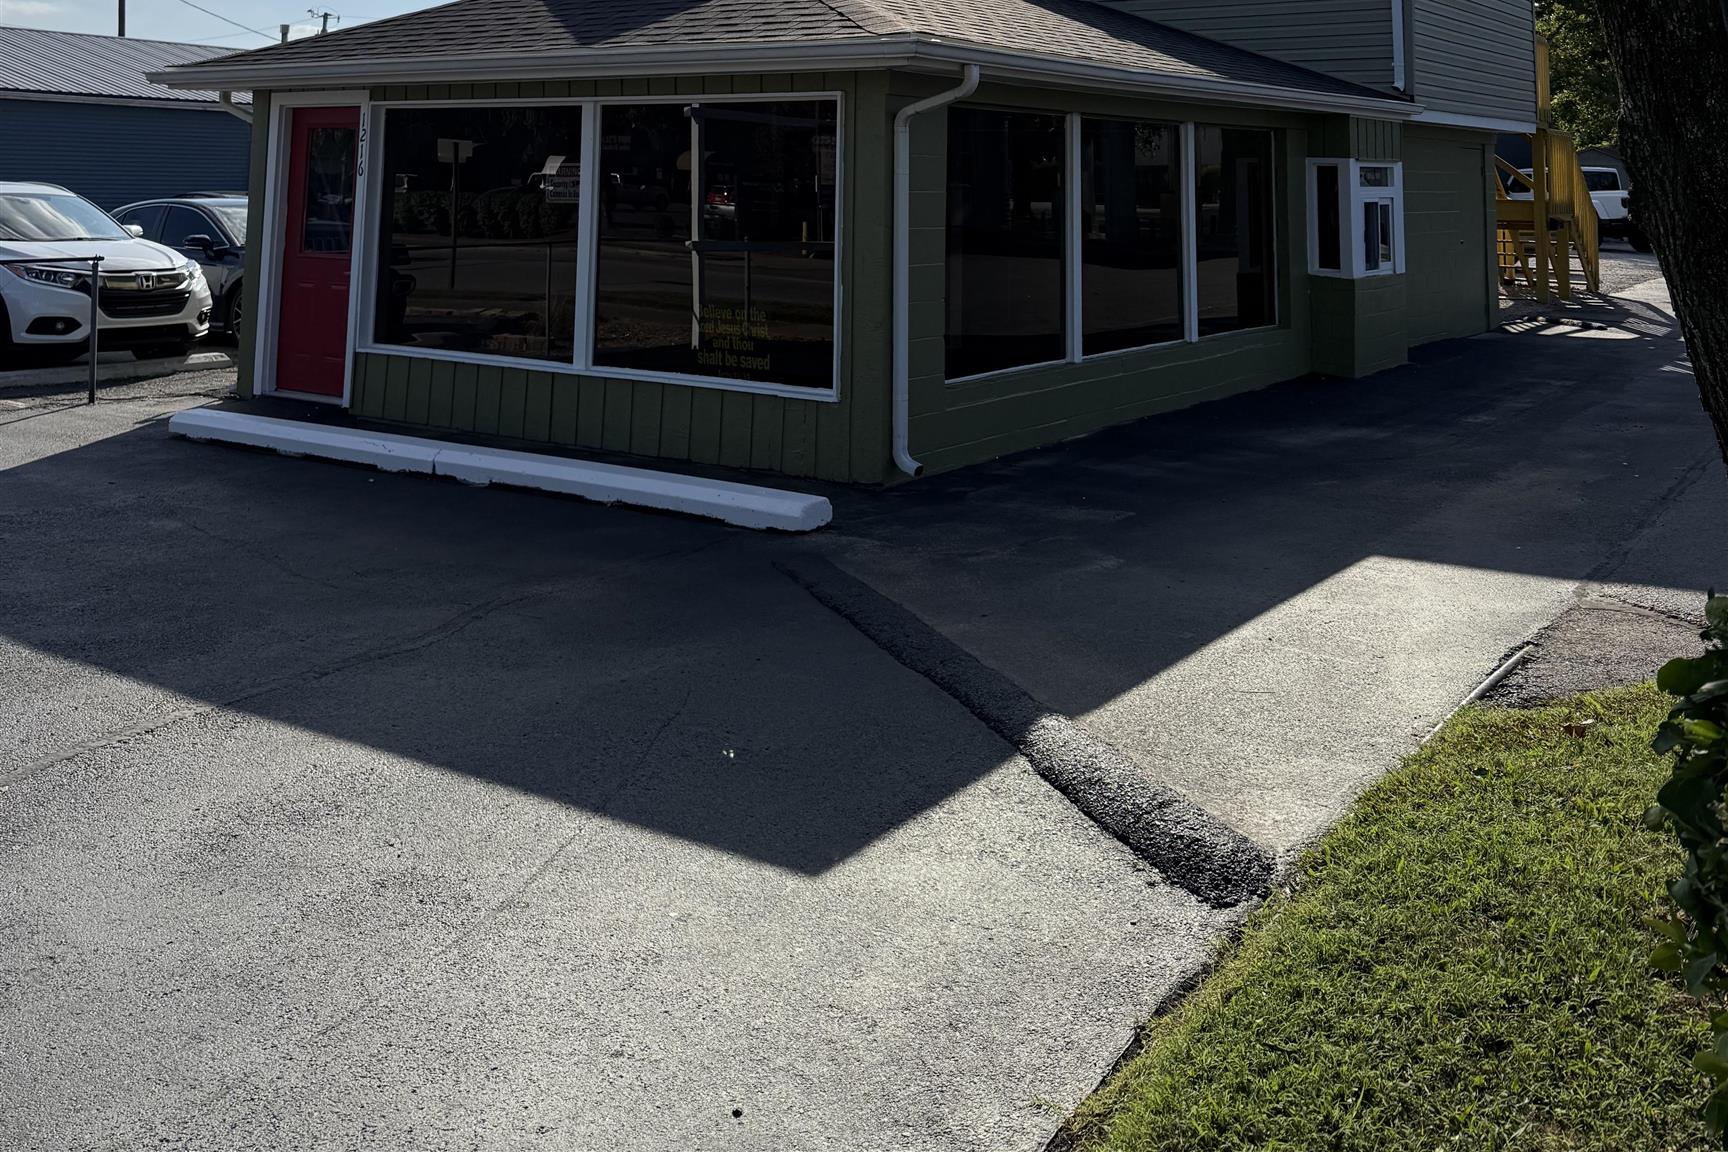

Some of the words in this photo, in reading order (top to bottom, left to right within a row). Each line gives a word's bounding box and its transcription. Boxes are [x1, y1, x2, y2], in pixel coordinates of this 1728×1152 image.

[358, 112, 367, 177] 1216
[712, 336, 730, 350] and
[697, 349, 723, 366] shalt
[725, 350, 738, 367] be
[740, 354, 770, 371] saved
